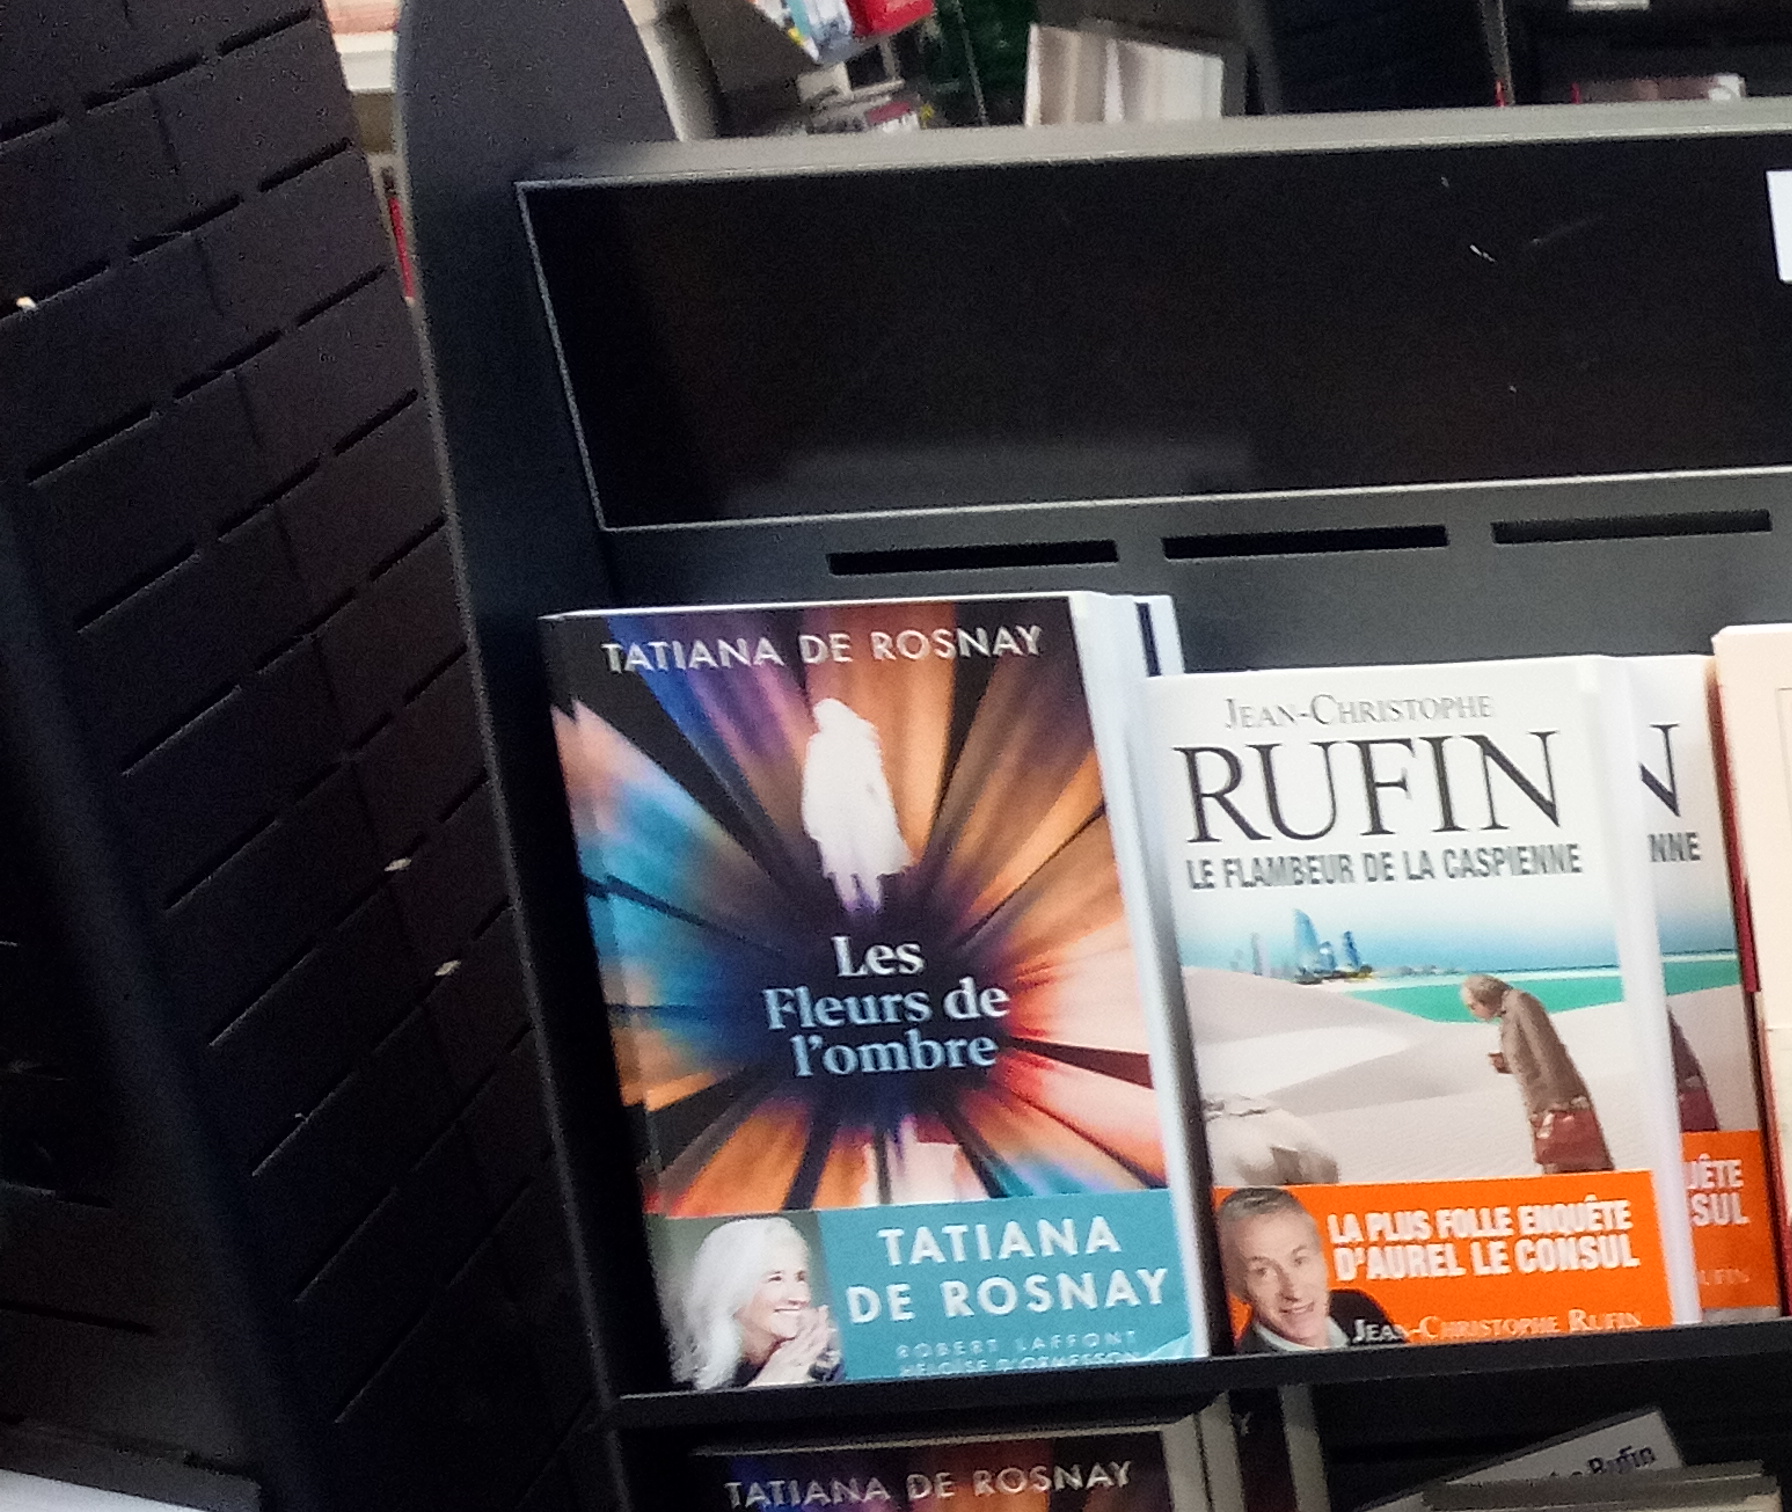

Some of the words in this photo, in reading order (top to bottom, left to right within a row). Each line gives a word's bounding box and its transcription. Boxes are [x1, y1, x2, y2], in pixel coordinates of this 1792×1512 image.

[603, 634, 784, 676] TATIANA
[801, 632, 851, 665] DE
[871, 624, 1043, 662] ROSNAY
[1172, 730, 1561, 845] RUFIN
[1186, 860, 1215, 890] LE
[1222, 851, 1354, 888] FLAMBEUR
[1362, 850, 1395, 881] DE
[1404, 849, 1436, 880] LA
[1445, 842, 1582, 879] CASPIENNE
[832, 936, 926, 980] Les
[764, 985, 932, 1032] Fleurs
[943, 981, 1010, 1019] de
[790, 1036, 999, 1079] l'ombre
[878, 1216, 1123, 1268] TATIANA
[1328, 1212, 1361, 1245] LA
[1368, 1210, 1432, 1242] PLUS
[1439, 1205, 1510, 1238] FOLLE
[1519, 1192, 1632, 1235] ENQUÊTE
[1335, 1244, 1458, 1281] D'AUREL
[1470, 1241, 1508, 1276] LE
[1515, 1234, 1640, 1272] CONSUL
[847, 1285, 915, 1324] DE
[944, 1268, 1169, 1316] ROSNAY
[725, 1476, 891, 1511] TATIANA
[908, 1472, 955, 1501] DE
[972, 1460, 1135, 1498] ROSNAY
